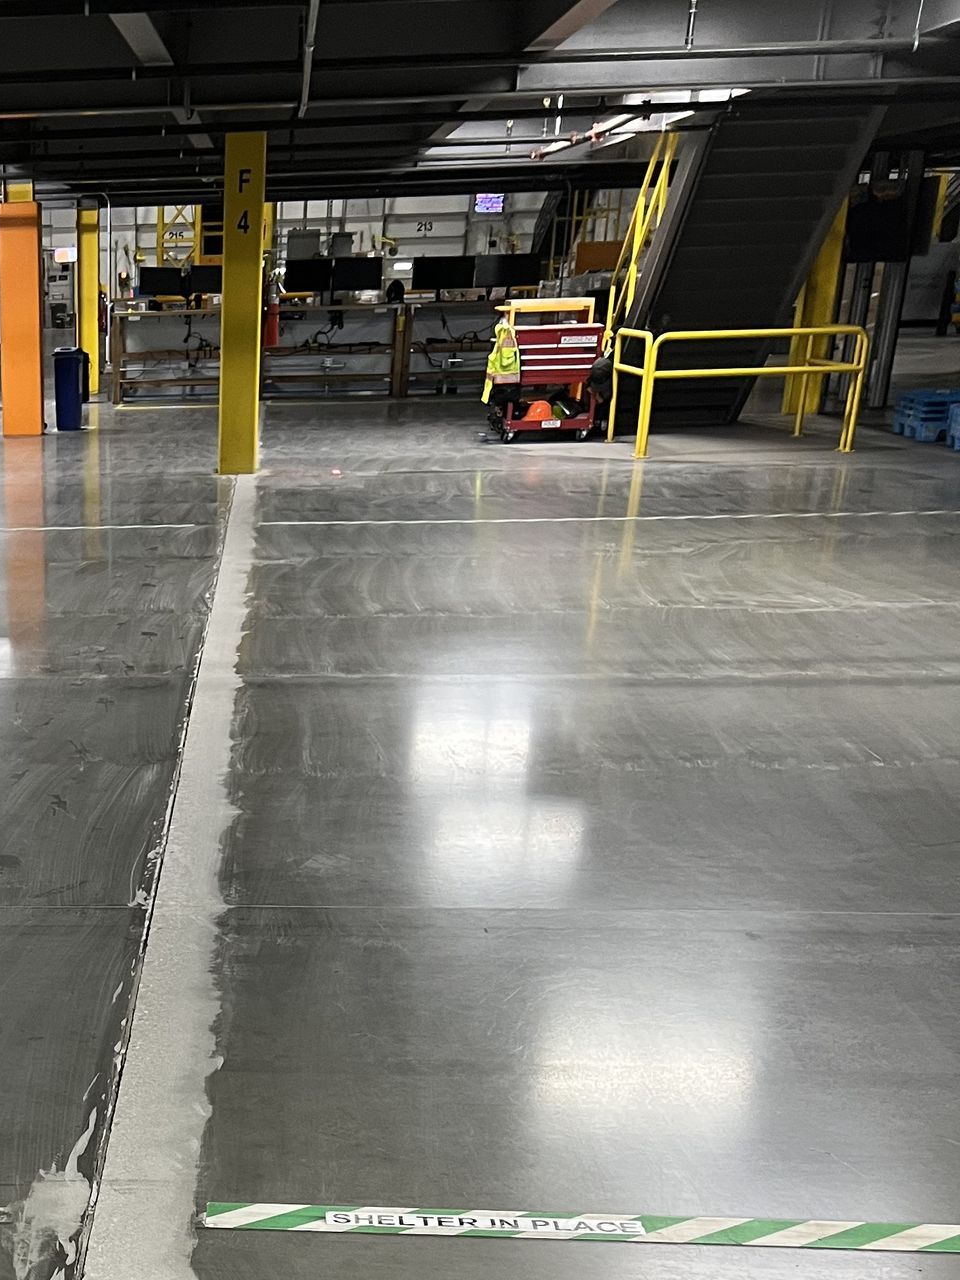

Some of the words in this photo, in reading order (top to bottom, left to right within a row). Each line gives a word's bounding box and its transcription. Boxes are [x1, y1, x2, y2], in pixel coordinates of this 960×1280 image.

[238, 168, 251, 193] F
[237, 209, 250, 235] 4
[417, 221, 433, 232] 213
[333, 1213, 478, 1228] SHELTER
[490, 1217, 519, 1229] IN
[532, 1219, 643, 1233] PLACE
